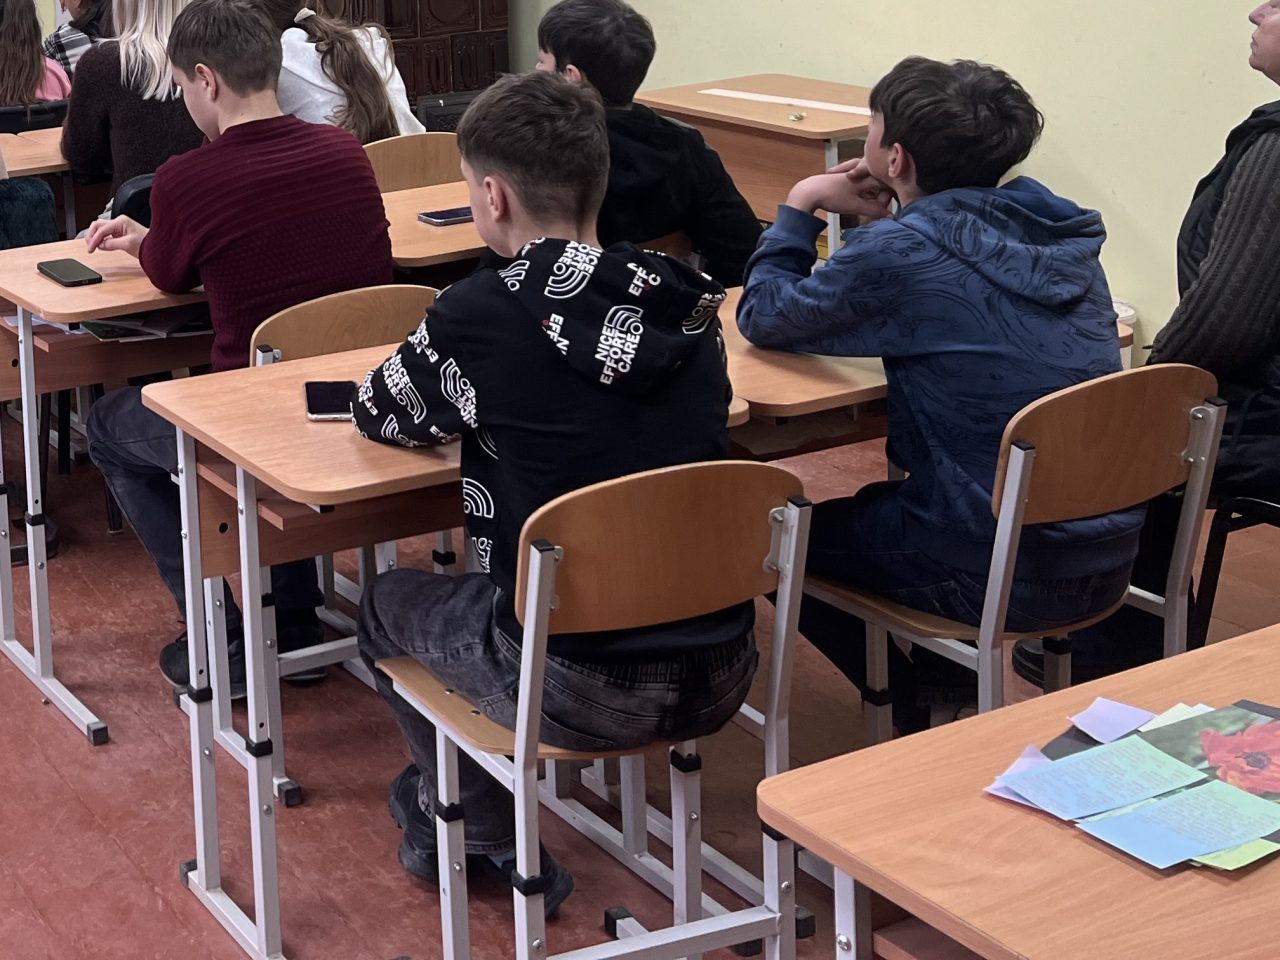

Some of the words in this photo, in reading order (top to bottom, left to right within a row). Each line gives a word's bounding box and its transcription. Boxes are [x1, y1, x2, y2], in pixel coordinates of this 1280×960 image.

[595, 326, 614, 361] NICE
[600, 329, 627, 385] EFFORT
[617, 333, 640, 373] CARE
